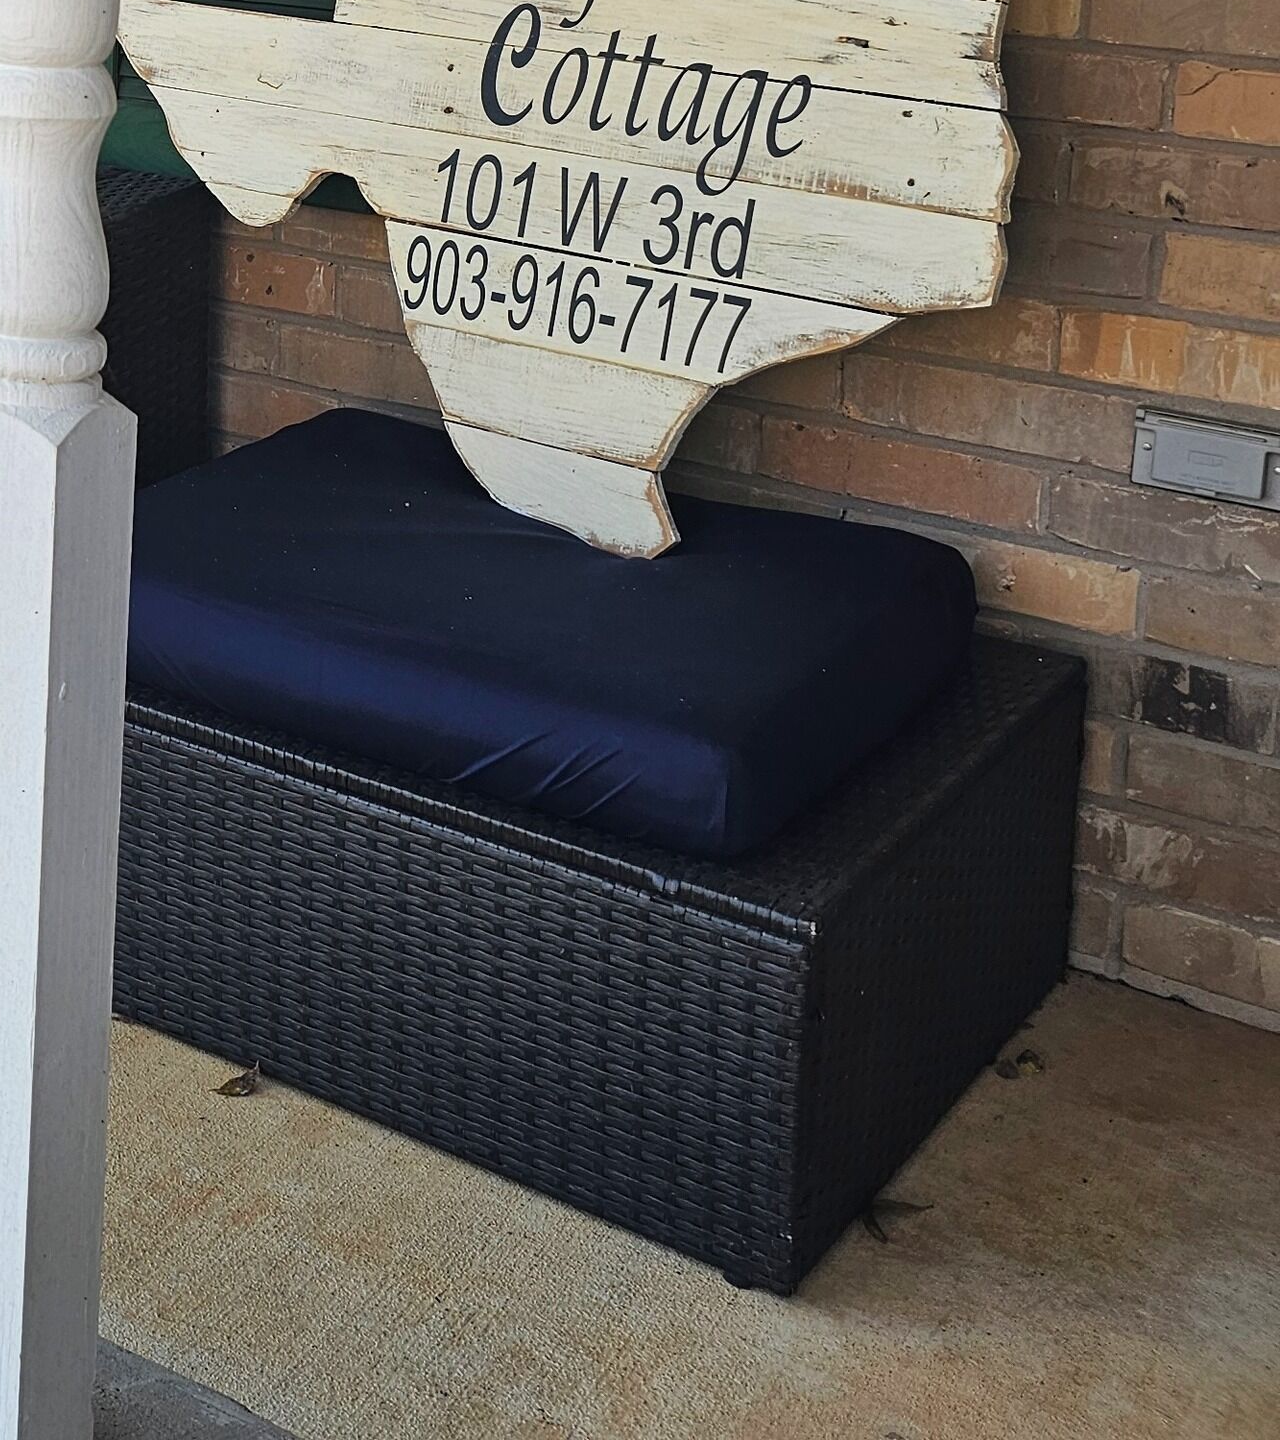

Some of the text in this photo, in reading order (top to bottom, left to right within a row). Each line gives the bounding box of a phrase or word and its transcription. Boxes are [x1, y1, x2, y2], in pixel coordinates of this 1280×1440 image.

[480, 2, 813, 197] Cottage
[436, 148, 756, 280] 101 W 3rd
[403, 235, 753, 375] 903-916-7177
